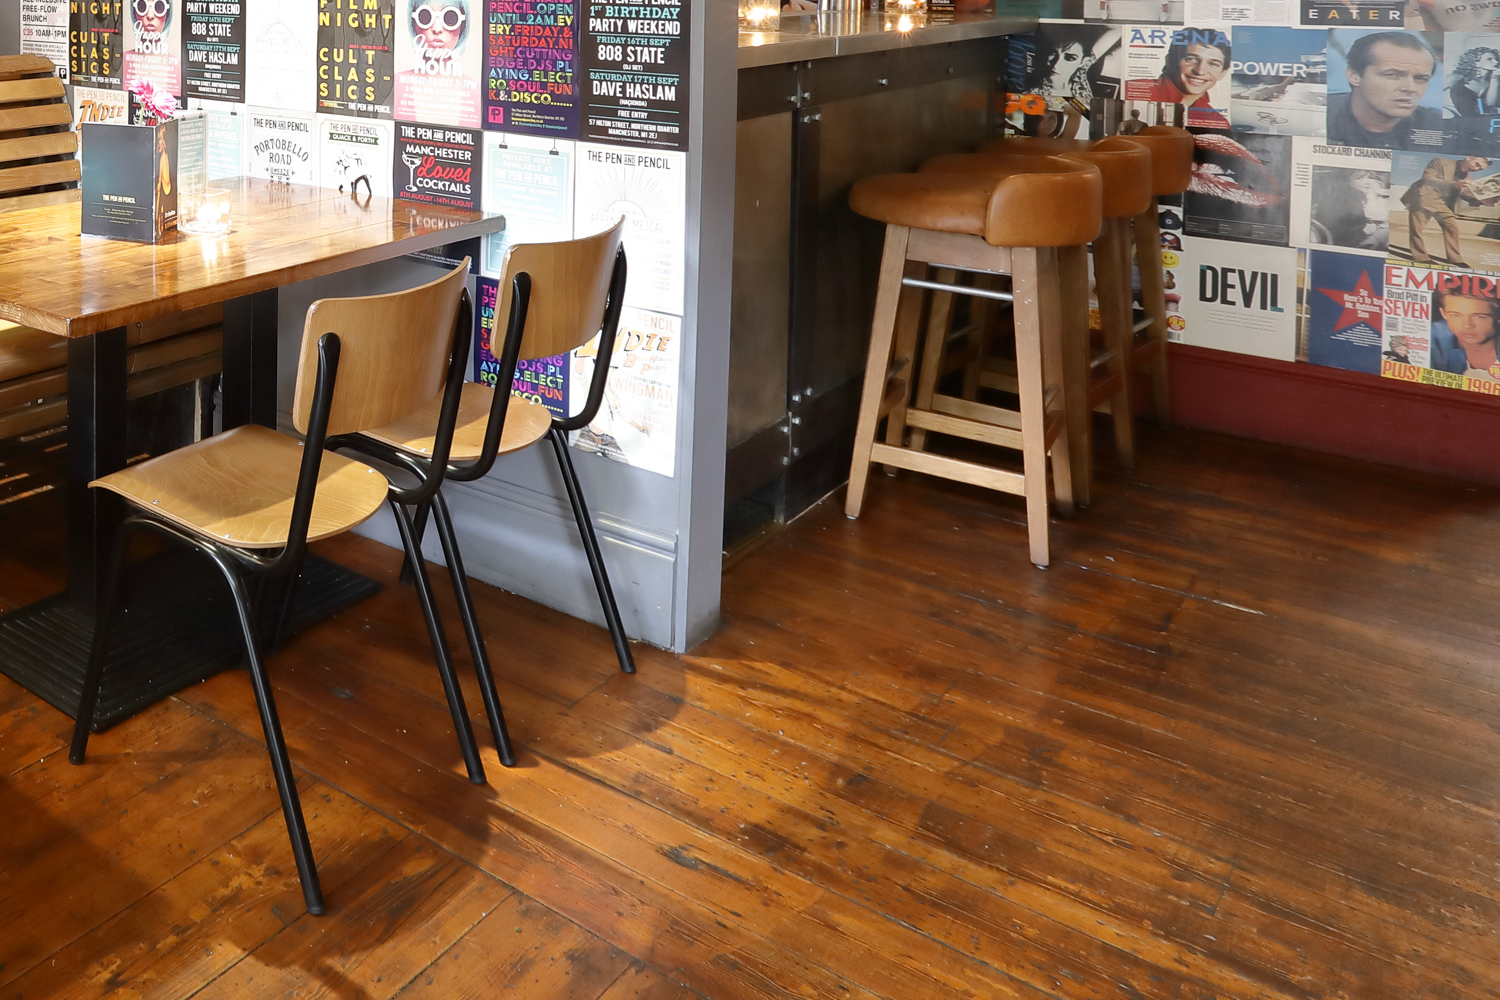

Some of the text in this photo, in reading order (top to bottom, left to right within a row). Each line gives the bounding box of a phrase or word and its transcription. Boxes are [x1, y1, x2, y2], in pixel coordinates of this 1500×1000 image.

[23, 5, 57, 13] FREE-FLOW
[71, 2, 121, 15] NIGHT
[187, 2, 240, 15] PARTY WEEKEND
[605, 6, 680, 19] BIRTHDAY
[319, 12, 392, 29] NIGHT
[589, 18, 680, 35] PARTY WEEKEND
[192, 23, 231, 37] 808 STATE
[597, 36, 671, 46] FRIDAY 16TH SEPT
[1130, 29, 1231, 48] ARENA
[135, 42, 168, 55] HOUR
[319, 47, 375, 64] CULT
[598, 45, 665, 64] 808 STATE
[189, 51, 238, 65] DAVE HASLAM
[414, 60, 463, 76] HOUR
[1231, 60, 1307, 78] POWER
[590, 72, 679, 85] SATURDAY 17TH SEPT
[106, 92, 126, 102] PENCIL
[319, 83, 375, 101] SICS
[593, 81, 676, 101] DAVE HASLAM
[631, 111, 648, 119] ENTRY
[253, 118, 309, 133] THE PEN PENCIL
[631, 123, 679, 133] NORTHERN QUARTER
[332, 133, 375, 144] QUACK FORTH
[401, 125, 415, 138] THE
[416, 127, 433, 140] PEN
[445, 131, 474, 145] PENCIL
[254, 138, 309, 162] PORTOBELLO
[405, 144, 472, 161] MANCHESTER
[1312, 145, 1353, 156] STOCKARD
[269, 152, 292, 166] ROAD
[502, 153, 532, 163] PRIVATE
[587, 150, 671, 170] THE PEN PENCIL
[417, 155, 472, 183] Loves
[502, 161, 542, 173] AVAILABLE
[416, 177, 472, 194] COCKTAILS
[1199, 264, 1284, 313] DEVIL
[1387, 290, 1404, 300] Brad
[1384, 298, 1429, 320] SEVEN
[1383, 361, 1421, 382] PLUS!
